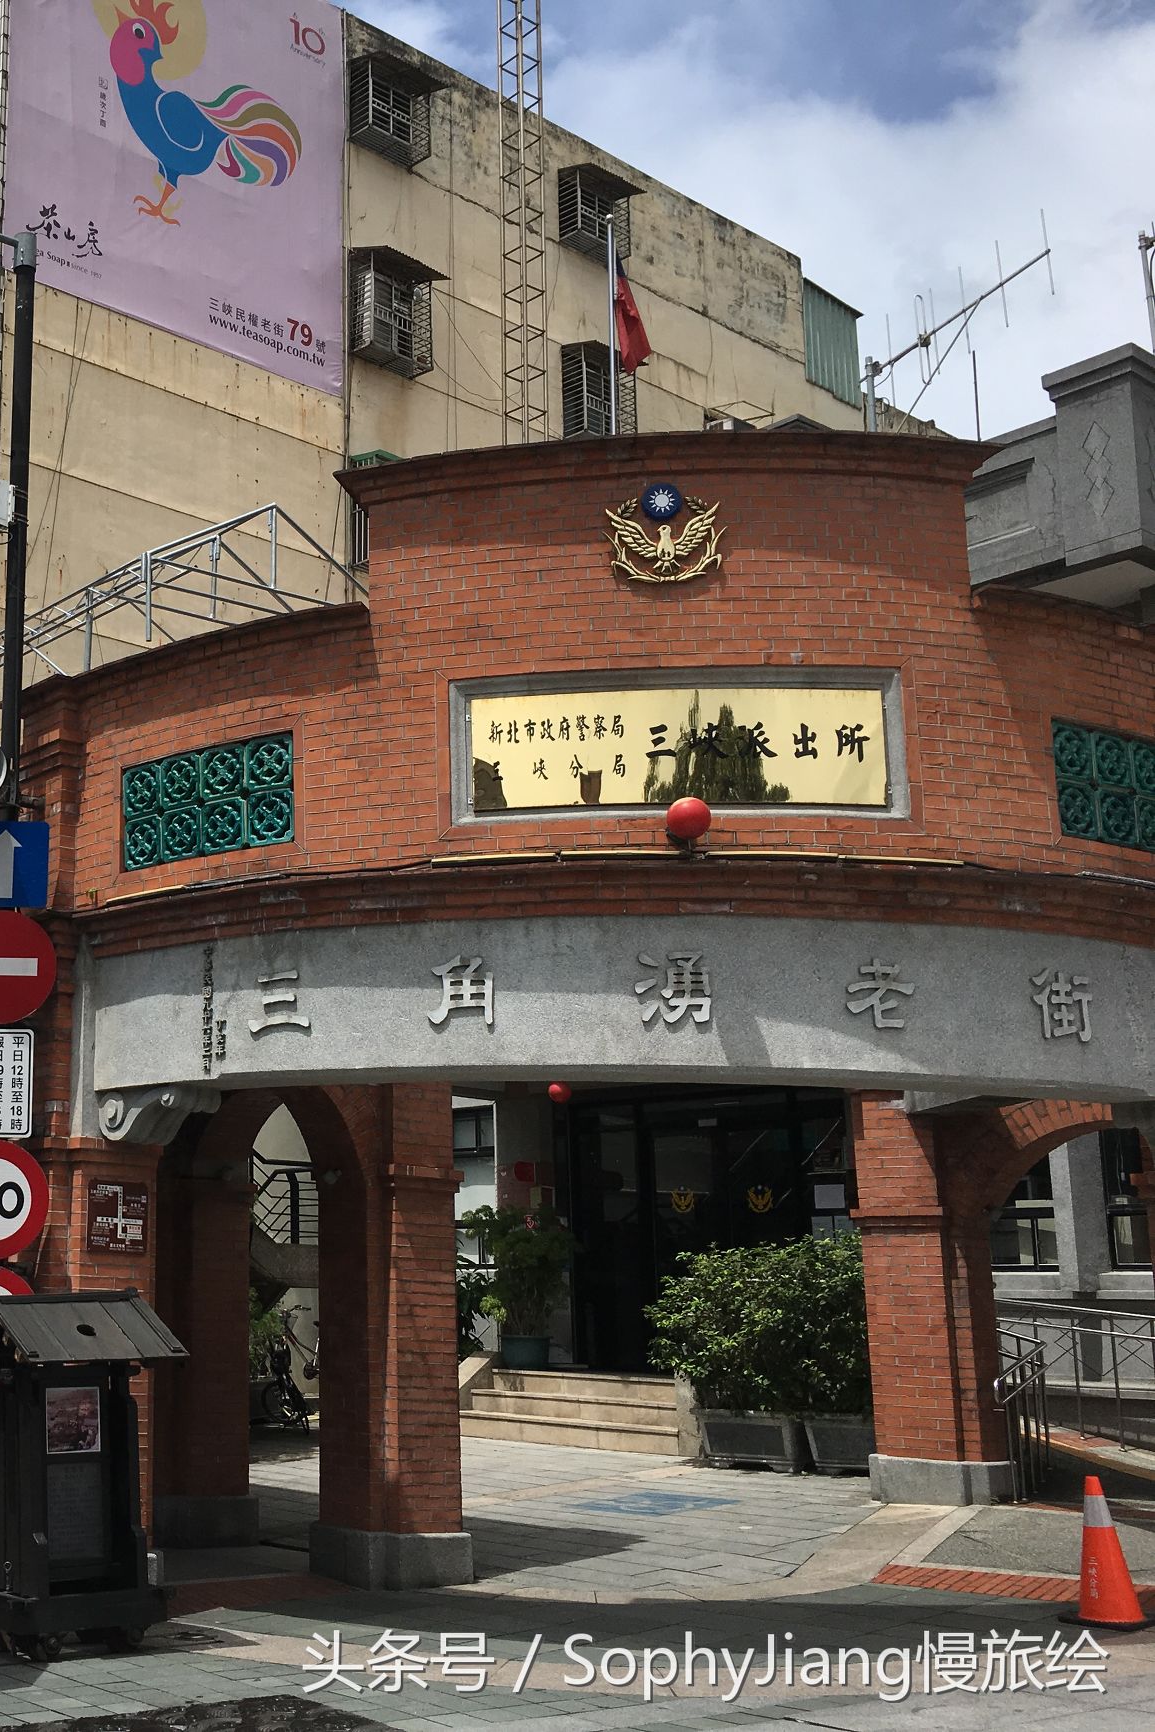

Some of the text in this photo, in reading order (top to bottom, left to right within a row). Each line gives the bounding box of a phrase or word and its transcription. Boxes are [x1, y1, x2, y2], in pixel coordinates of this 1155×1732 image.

[289, 17, 326, 55] 10
[46, 250, 66, 267] Soap
[208, 314, 326, 367] www.teasoap.com.tw
[488, 713, 625, 747] 新北市政府警察局
[644, 722, 871, 764] 三峽派出所
[492, 753, 627, 781] 三峽分局
[248, 951, 1093, 1043] 三角湧老街
[10, 1035, 25, 1131] 平日12時至18時
